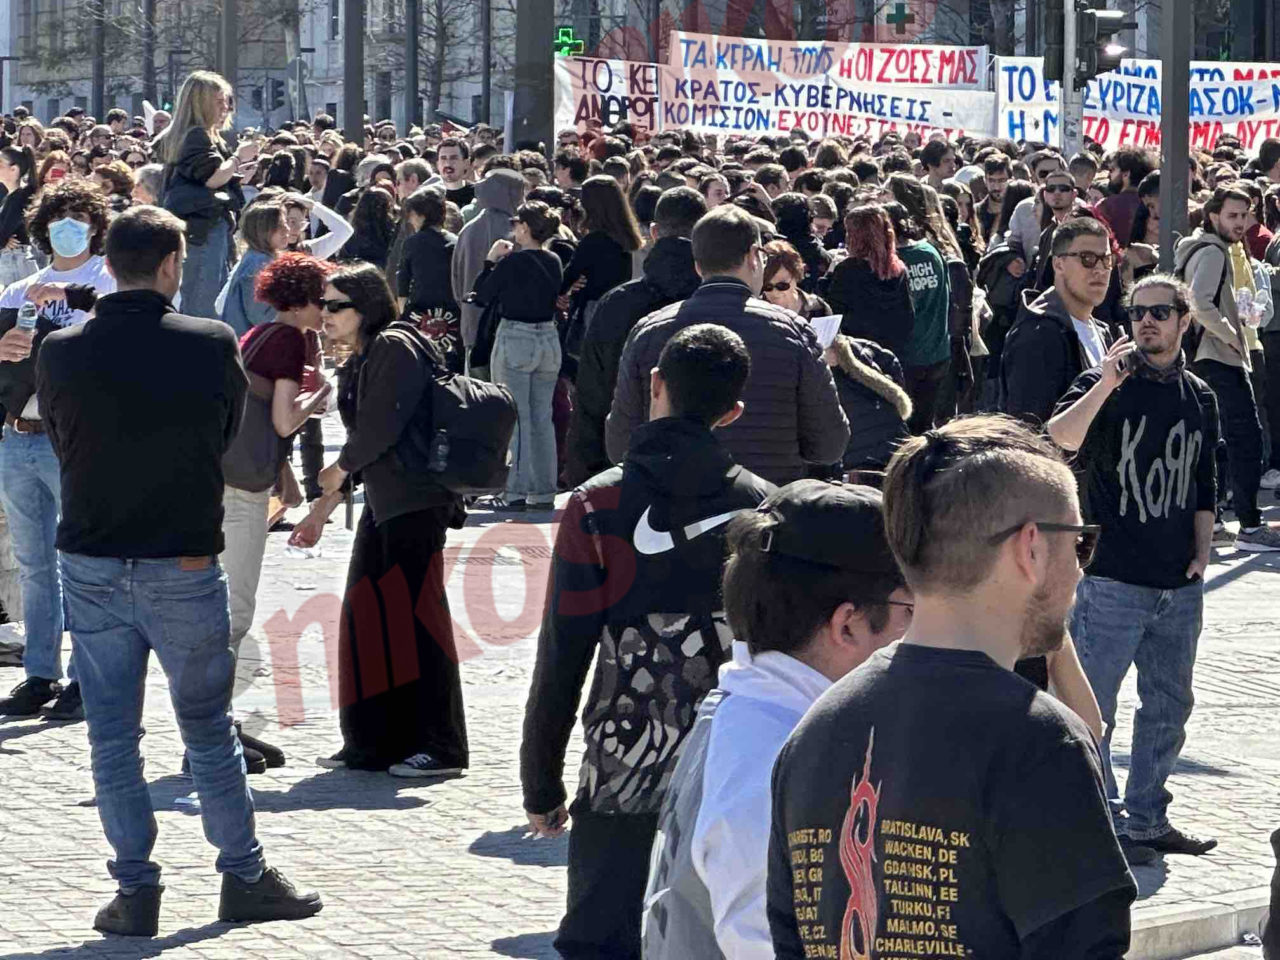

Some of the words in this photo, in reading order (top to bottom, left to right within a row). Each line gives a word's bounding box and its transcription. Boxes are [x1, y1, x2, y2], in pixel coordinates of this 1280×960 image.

[679, 39, 715, 71] ΤΑ
[855, 47, 875, 82] ΟΙ
[938, 49, 979, 85] ΜΑΣ
[573, 57, 613, 94] ΤΟ
[1001, 65, 1036, 103] ΤΟ
[906, 261, 934, 278] HIGH
[950, 832, 970, 847] SK
[884, 840, 935, 862] WACKEN,
[938, 849, 957, 864] DE
[939, 868, 958, 882] PL
[883, 879, 936, 901] TALLINN,
[940, 887, 958, 901] EE
[891, 899, 936, 919] TURKU,
[941, 925, 957, 939] SE
